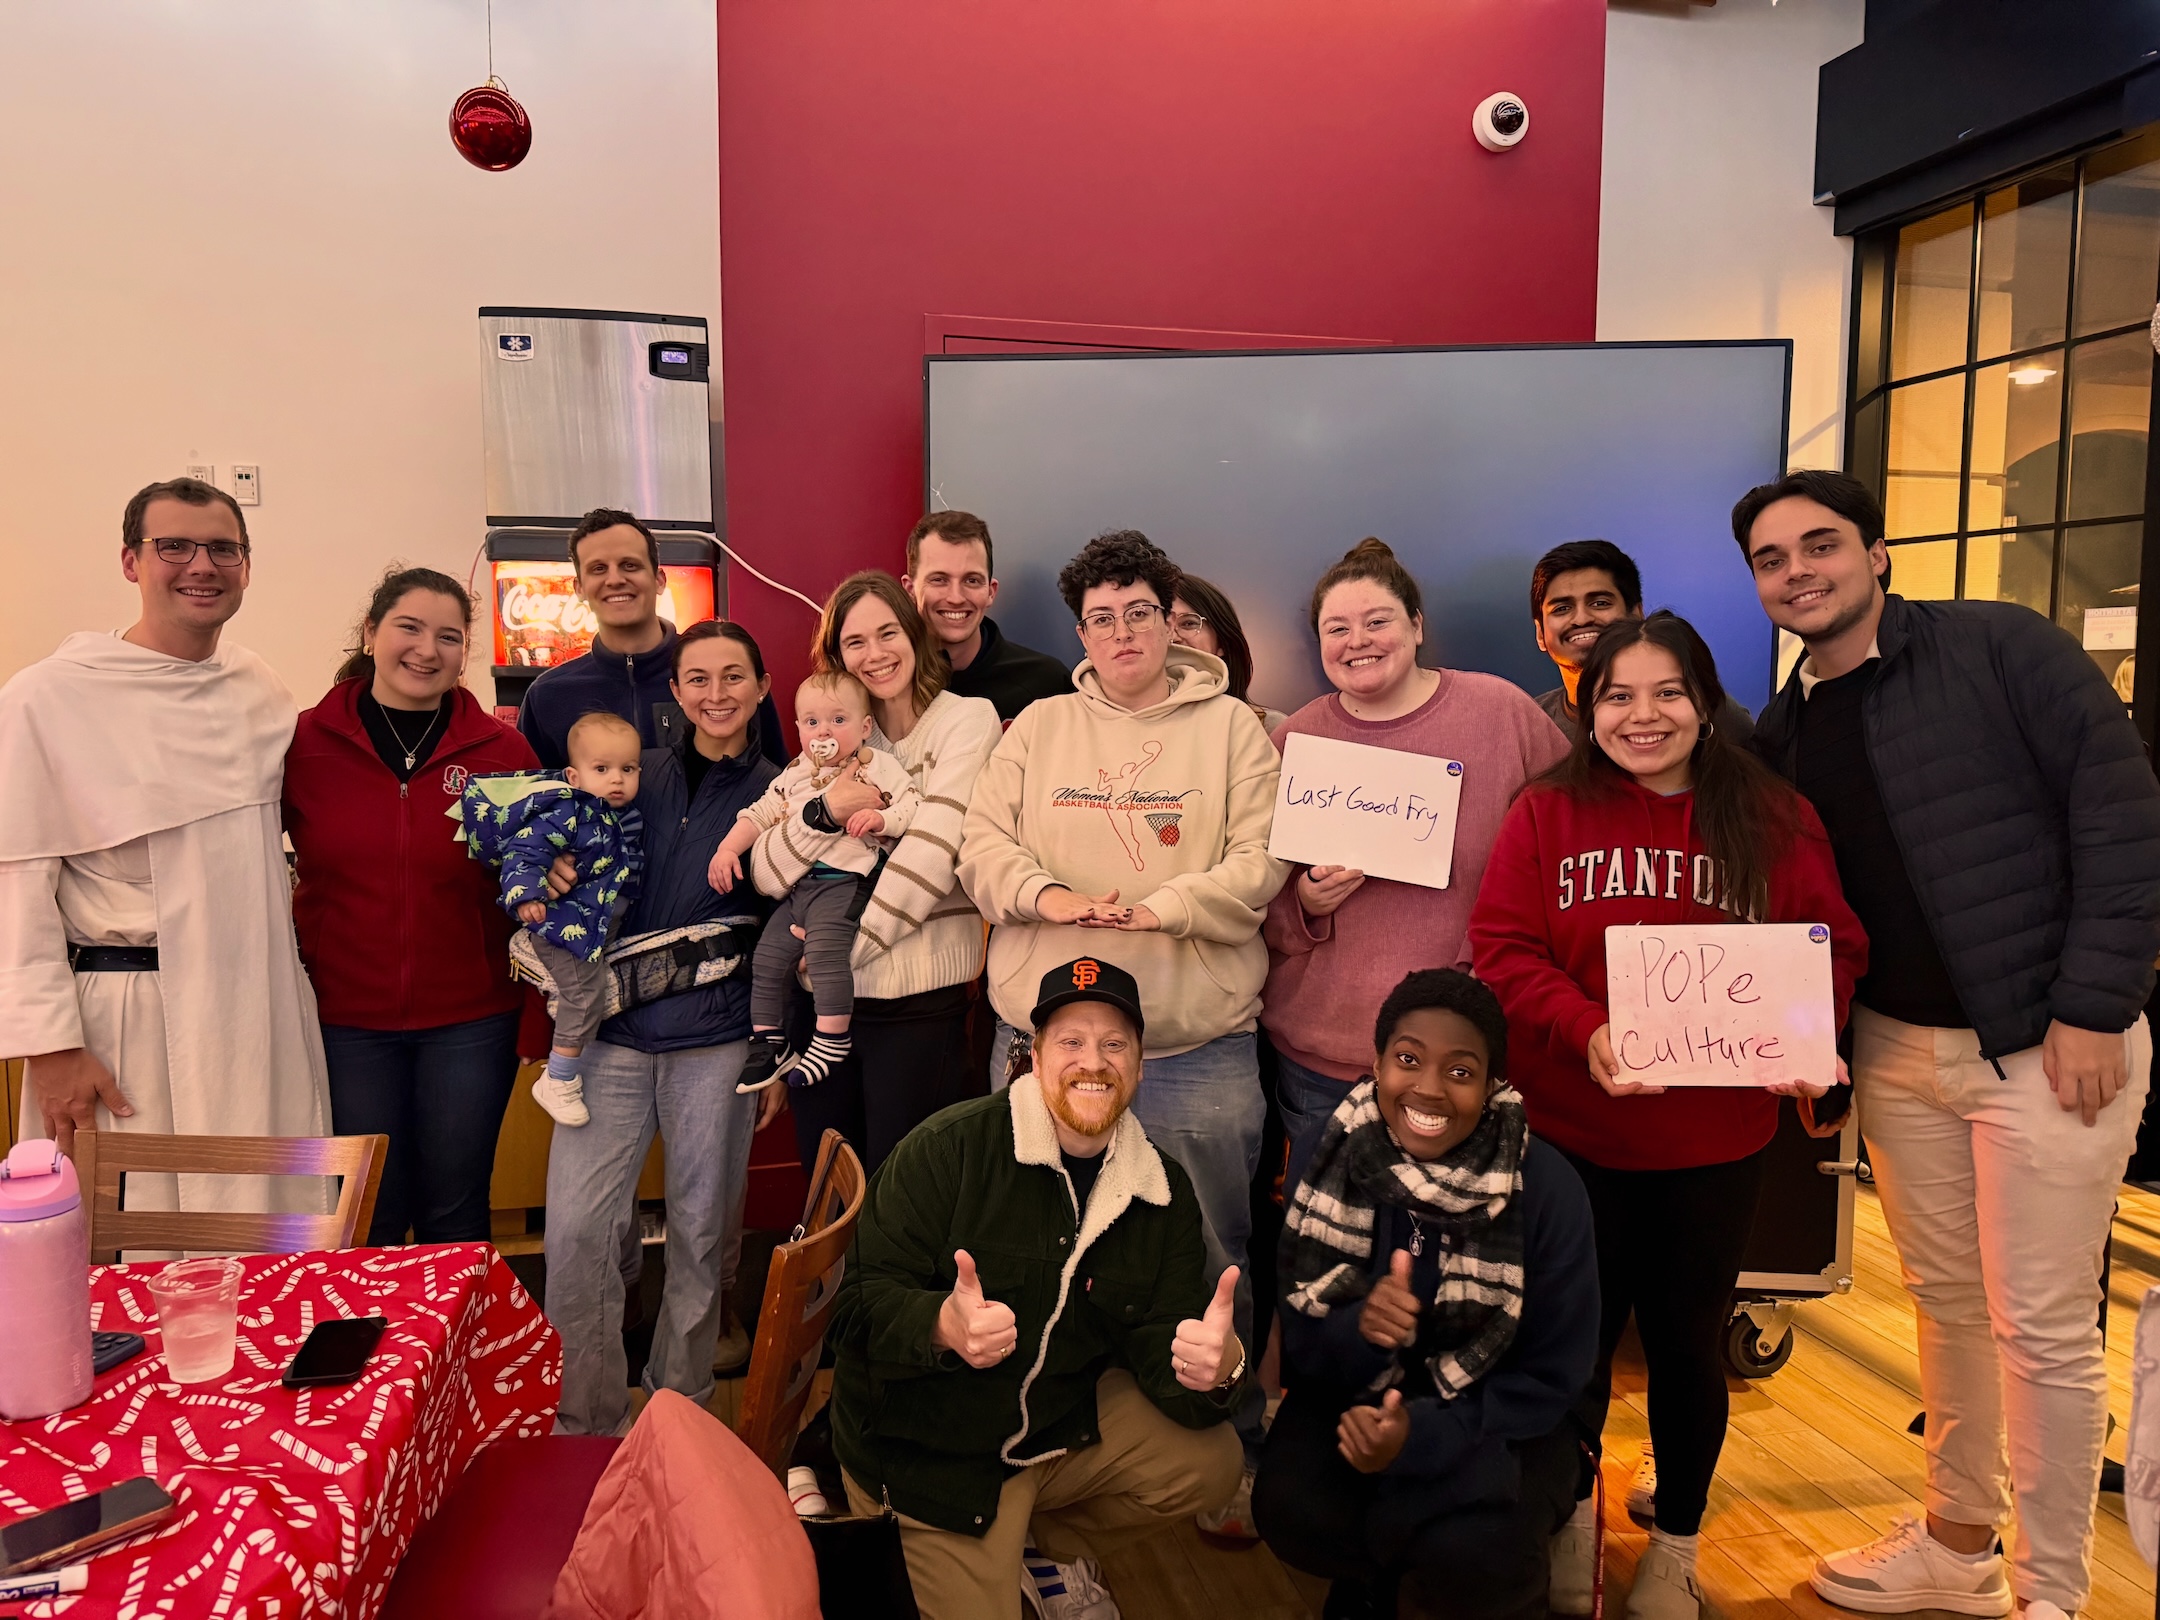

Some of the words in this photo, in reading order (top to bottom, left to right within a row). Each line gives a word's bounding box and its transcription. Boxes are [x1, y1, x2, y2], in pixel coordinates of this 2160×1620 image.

[502, 584, 599, 633] Coca-Co
[1052, 787, 1113, 802] Women's
[1115, 789, 1203, 804] National
[1052, 800, 1114, 810] BASKETBALL
[1116, 802, 1183, 811] ASSOCIATION
[1287, 776, 1342, 808] Last
[1346, 786, 1399, 815] Good
[1406, 795, 1438, 841] Fry
[1558, 846, 1767, 924] STANFO
[1072, 960, 1101, 991] SF
[1620, 1026, 1785, 1070] Culture
